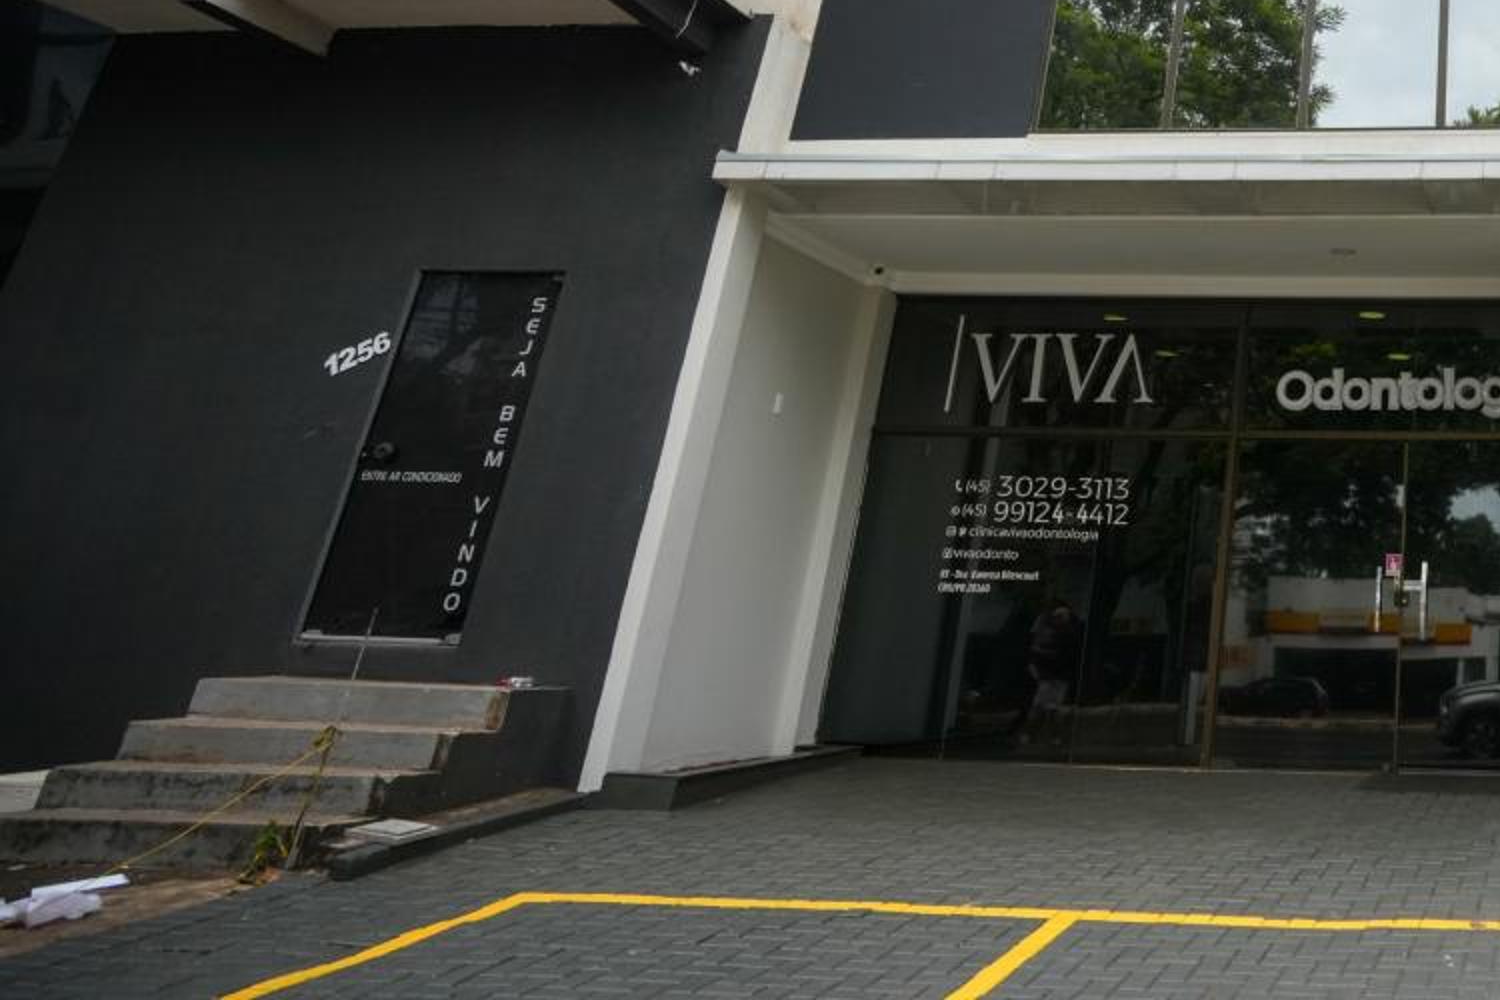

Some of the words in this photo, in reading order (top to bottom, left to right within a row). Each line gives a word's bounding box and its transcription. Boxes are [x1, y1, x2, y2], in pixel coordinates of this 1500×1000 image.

[324, 331, 391, 376] 1256
[511, 297, 548, 378] SEJA
[970, 332, 1153, 403] VIVA
[483, 404, 516, 468] BEM
[993, 501, 1130, 525] 99124-4412
[997, 475, 1130, 500] 3029-3113
[443, 496, 491, 612] VINDO
